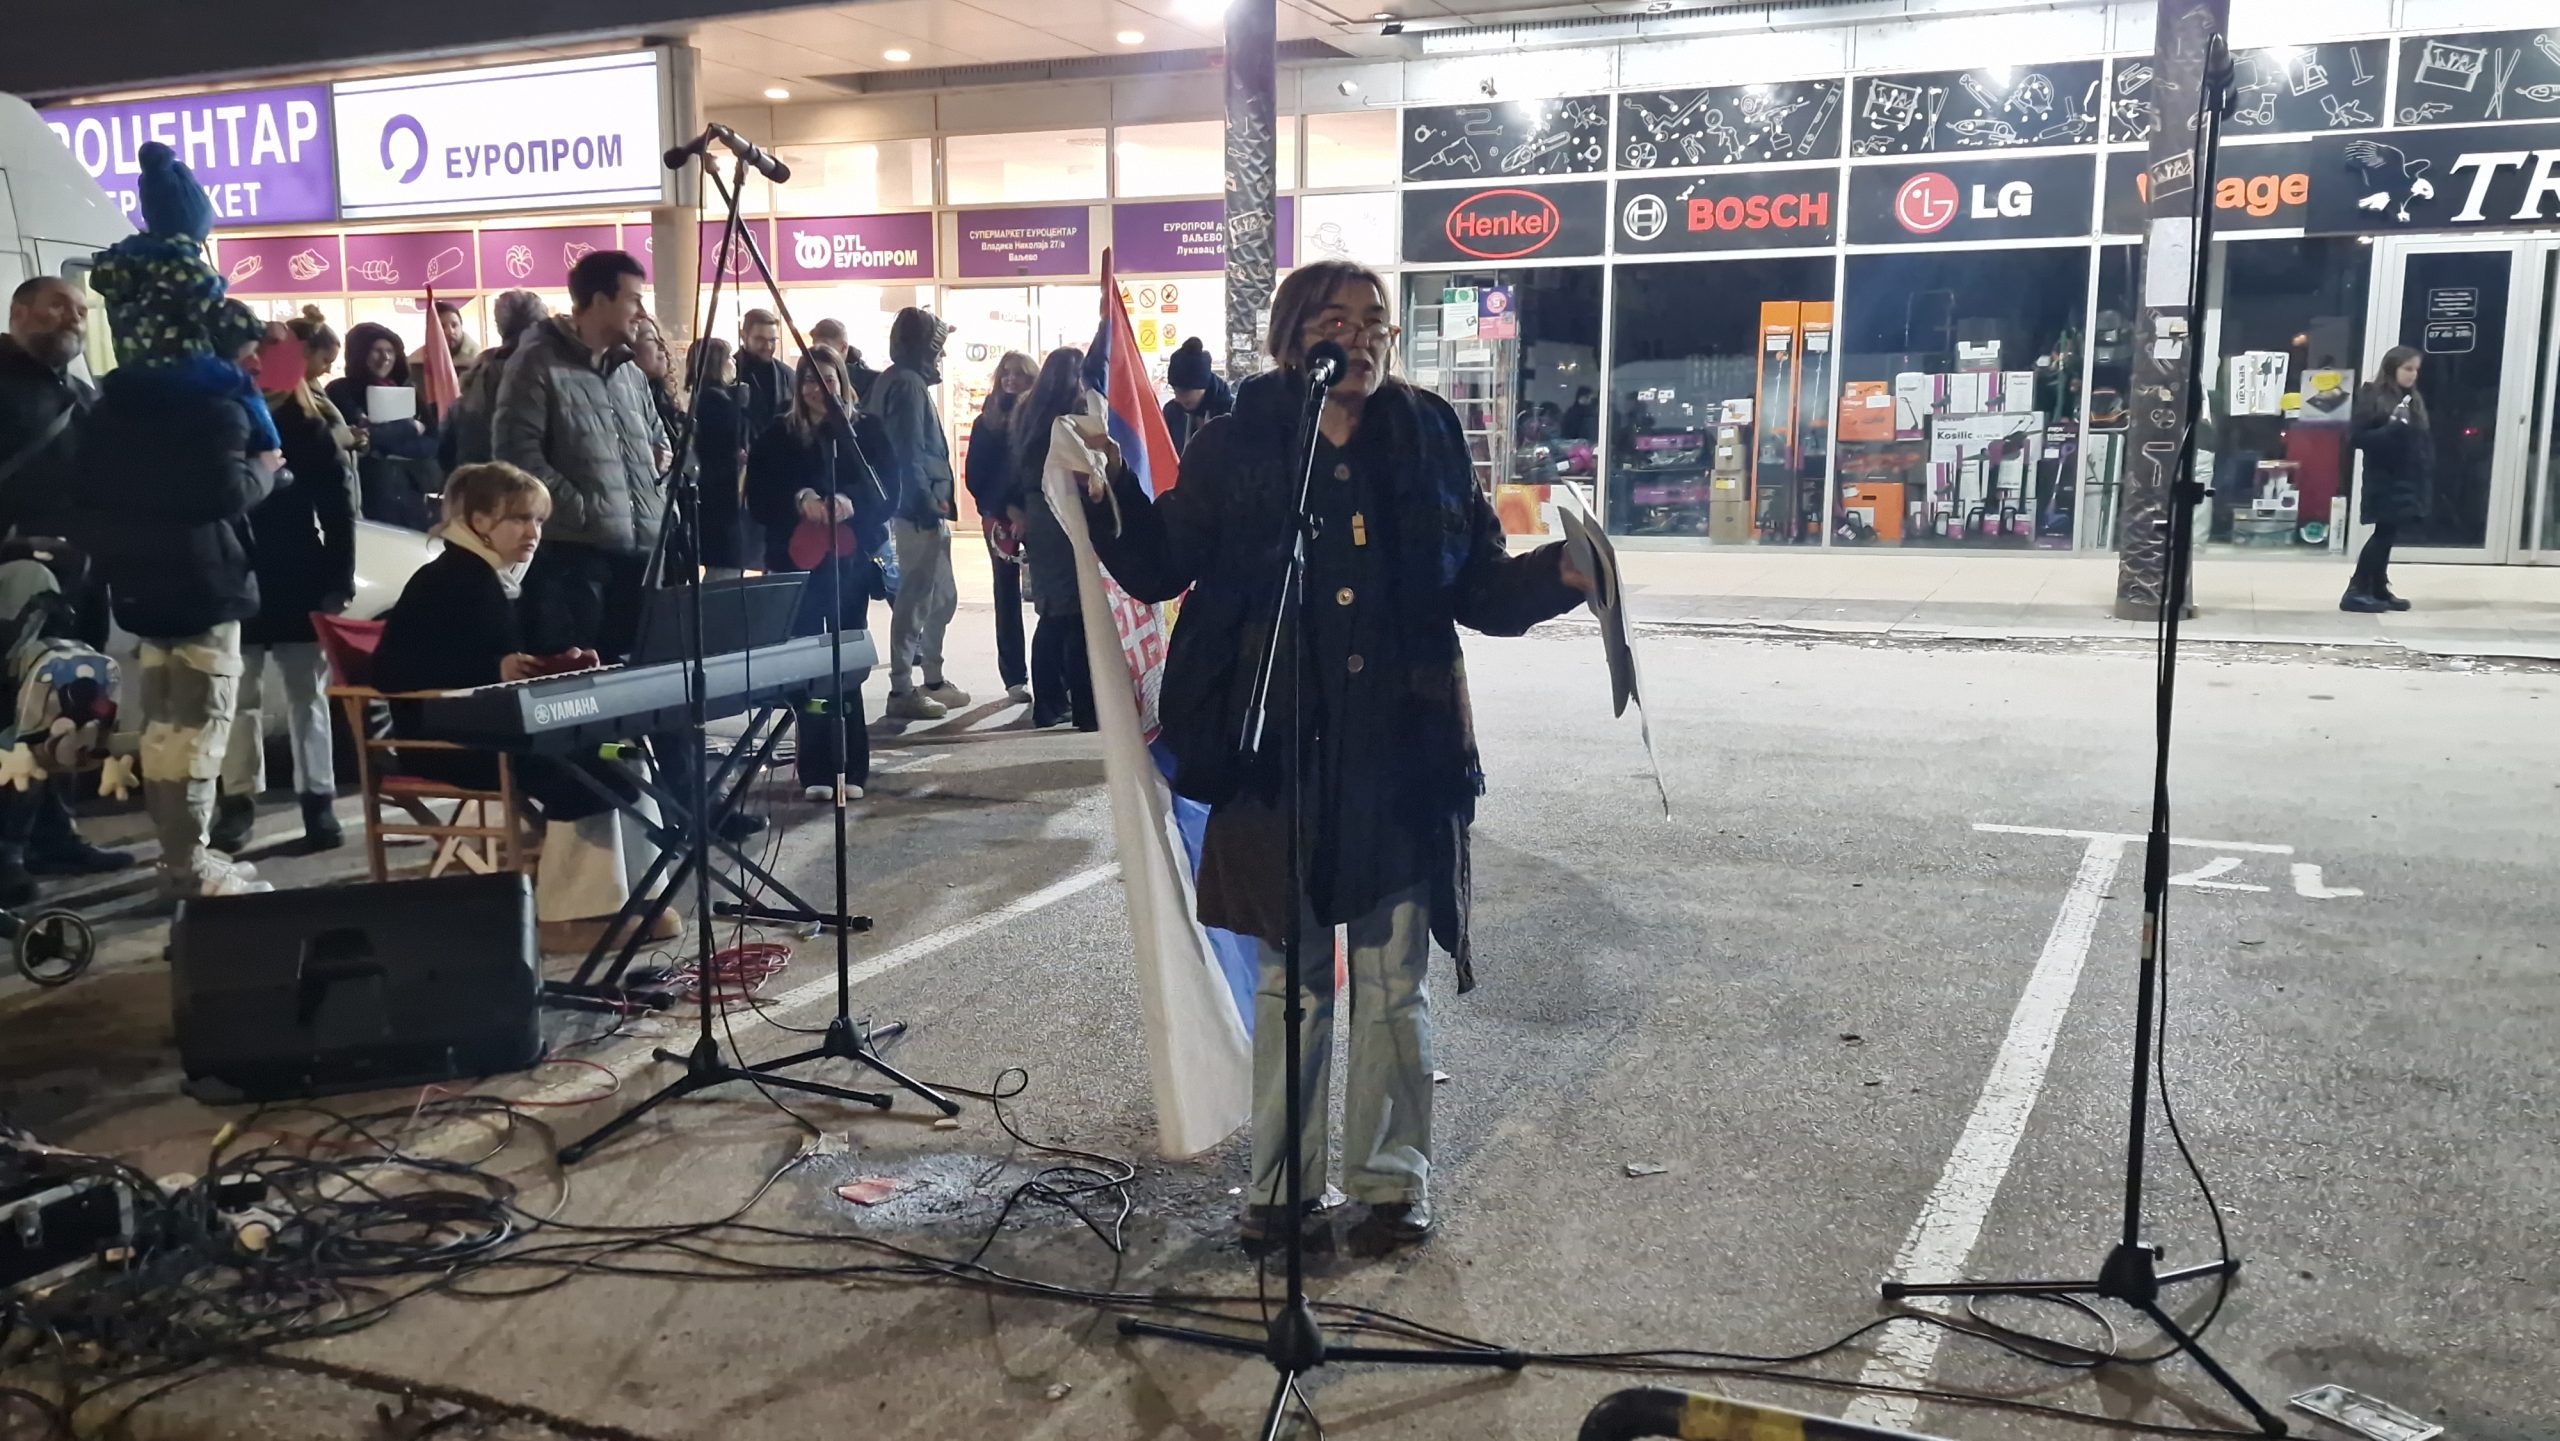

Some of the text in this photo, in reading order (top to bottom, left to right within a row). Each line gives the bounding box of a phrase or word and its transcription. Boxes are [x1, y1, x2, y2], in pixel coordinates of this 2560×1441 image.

[446, 134, 622, 178] ЕУРОПРОМ
[1971, 181, 2033, 218] LG
[2449, 149, 2560, 222] TR
[1455, 207, 1550, 238] Henkel
[1687, 192, 1828, 232] BOSCH
[969, 227, 1078, 240] СУПЕРМАРКЕТ ЕУРОЦЕНТАР
[1163, 221, 1214, 232] ЕУРОПРОМ
[833, 234, 866, 252] DTL
[833, 250, 918, 269] ЕУРОПРОМ
[549, 696, 599, 721] YAMAHA
